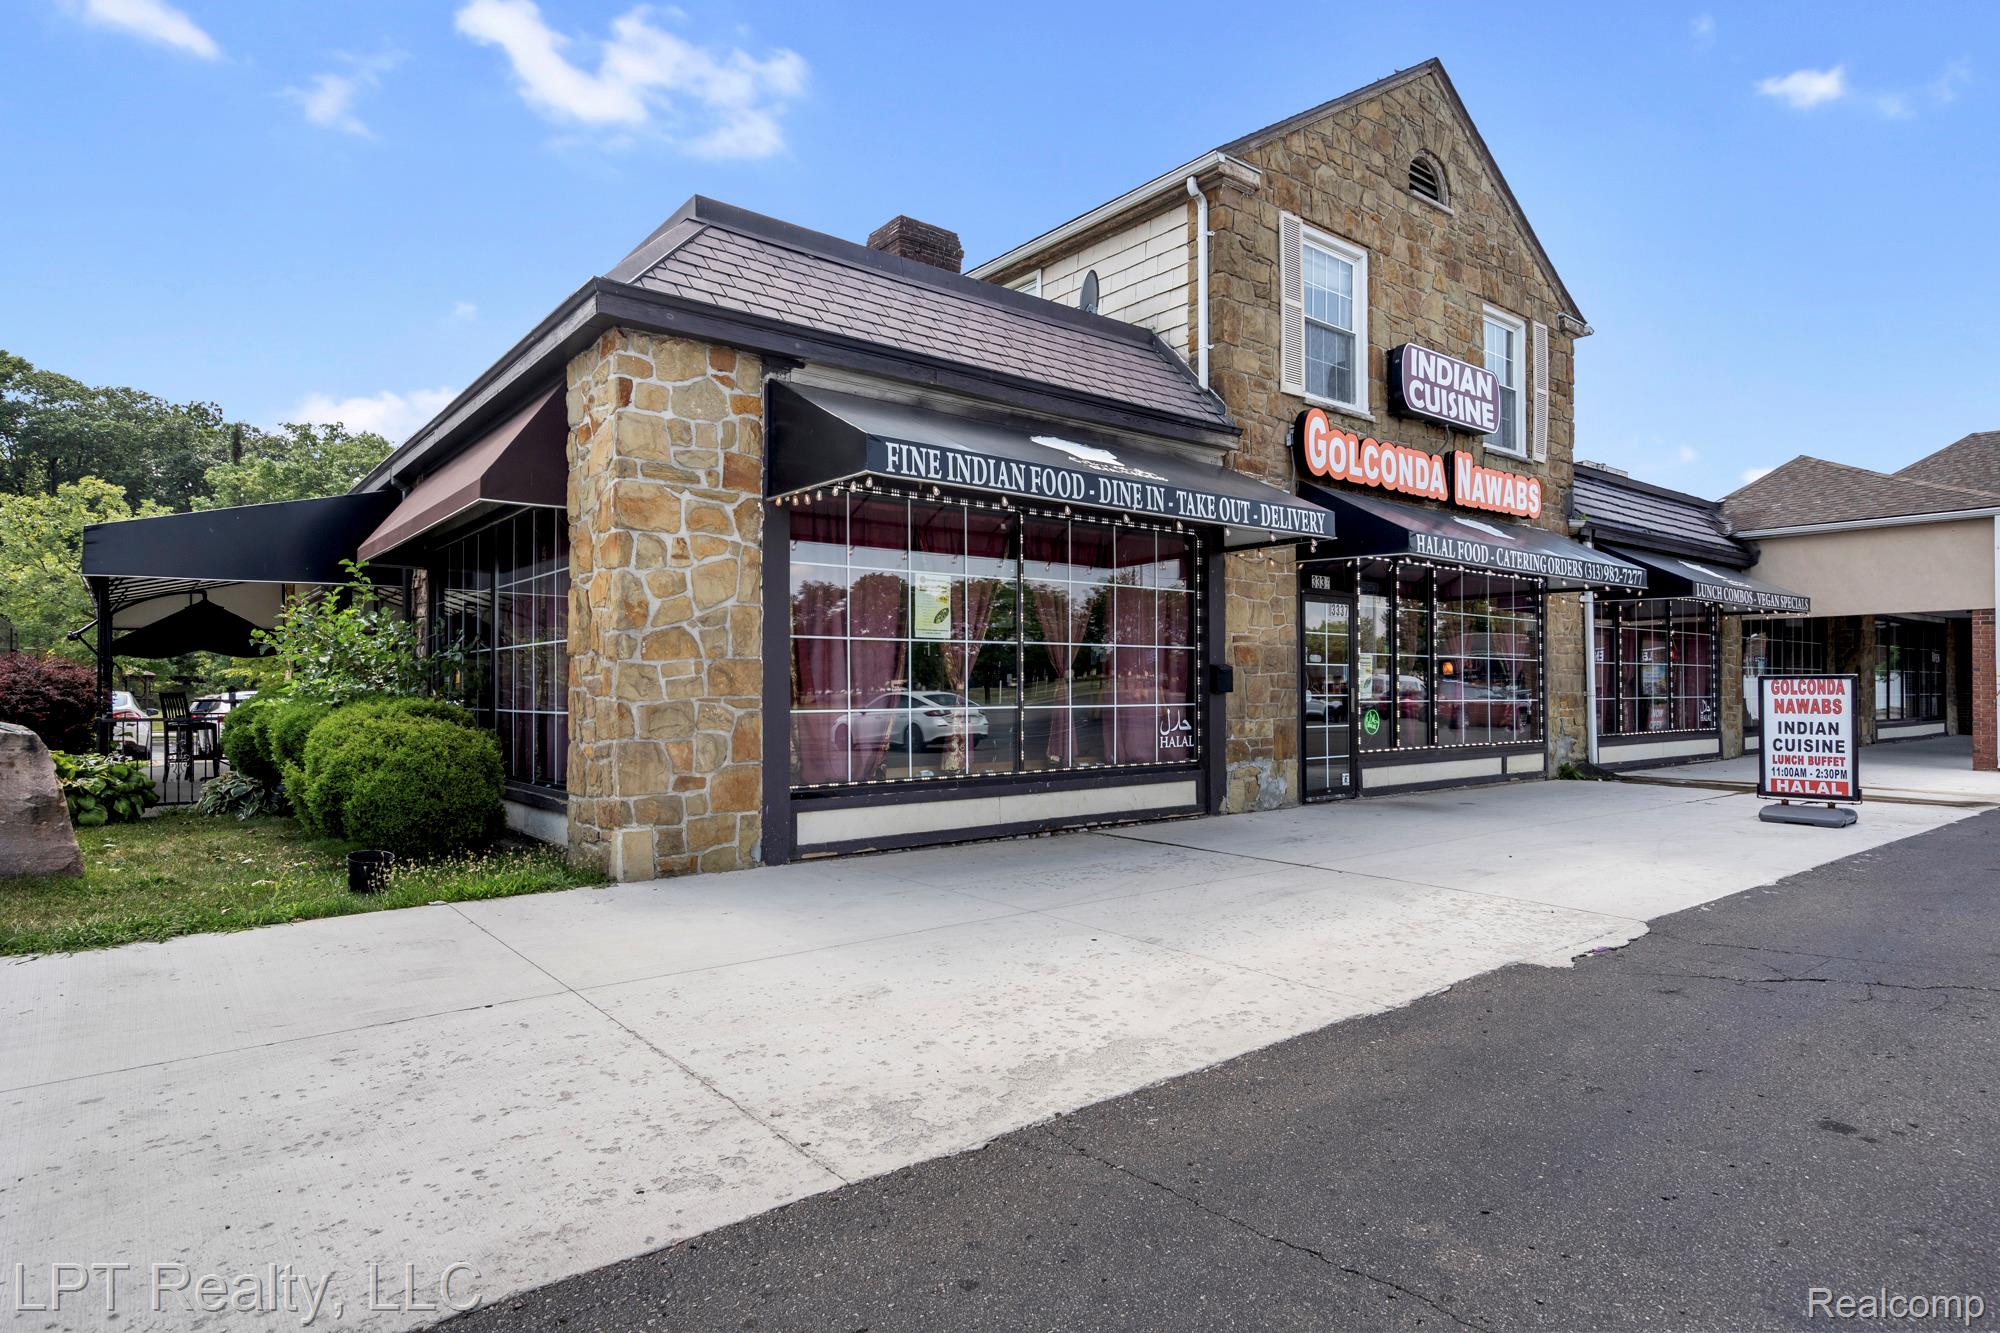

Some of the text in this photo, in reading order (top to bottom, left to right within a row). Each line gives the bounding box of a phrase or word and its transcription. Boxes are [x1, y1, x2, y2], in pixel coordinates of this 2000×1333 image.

[1411, 348, 1493, 401] INDIAN
[1409, 380, 1495, 430] CUISINE
[1308, 416, 1540, 514] GOLCONDA NAWABS
[885, 441, 943, 479] FINE
[946, 452, 1029, 491] INDIAN
[1030, 465, 1085, 500] FOOD
[1098, 477, 1143, 509] DINE
[1146, 485, 1165, 512] IN
[1176, 490, 1217, 520] TAKE
[1219, 497, 1250, 524] OUT
[1260, 503, 1326, 534] DELIVERY
[1416, 533, 1456, 559] HALAL
[1457, 540, 1489, 563] FOOD
[1496, 548, 1547, 574] CATERING
[1547, 555, 1583, 578] ORDERS
[1696, 582, 1722, 600] LUNCH
[1723, 587, 1753, 604] COMBOS
[1756, 592, 1781, 608] VEGAN
[1780, 595, 1809, 611] SPECIALS
[1770, 678, 1846, 696] GOLCONDA
[1774, 698, 1843, 715] NAWABS
[1160, 708, 1192, 736] حلال
[1777, 721, 1840, 736] INDIAN
[1160, 735, 1195, 748] HALAL
[1772, 738, 1846, 754] CUISINE
[1772, 754, 1846, 767] LUNCH BUFFET
[1771, 767, 1807, 778] 11:00AM
[1815, 768, 1848, 780] 2:30PM
[1776, 780, 1843, 795] HALAL
